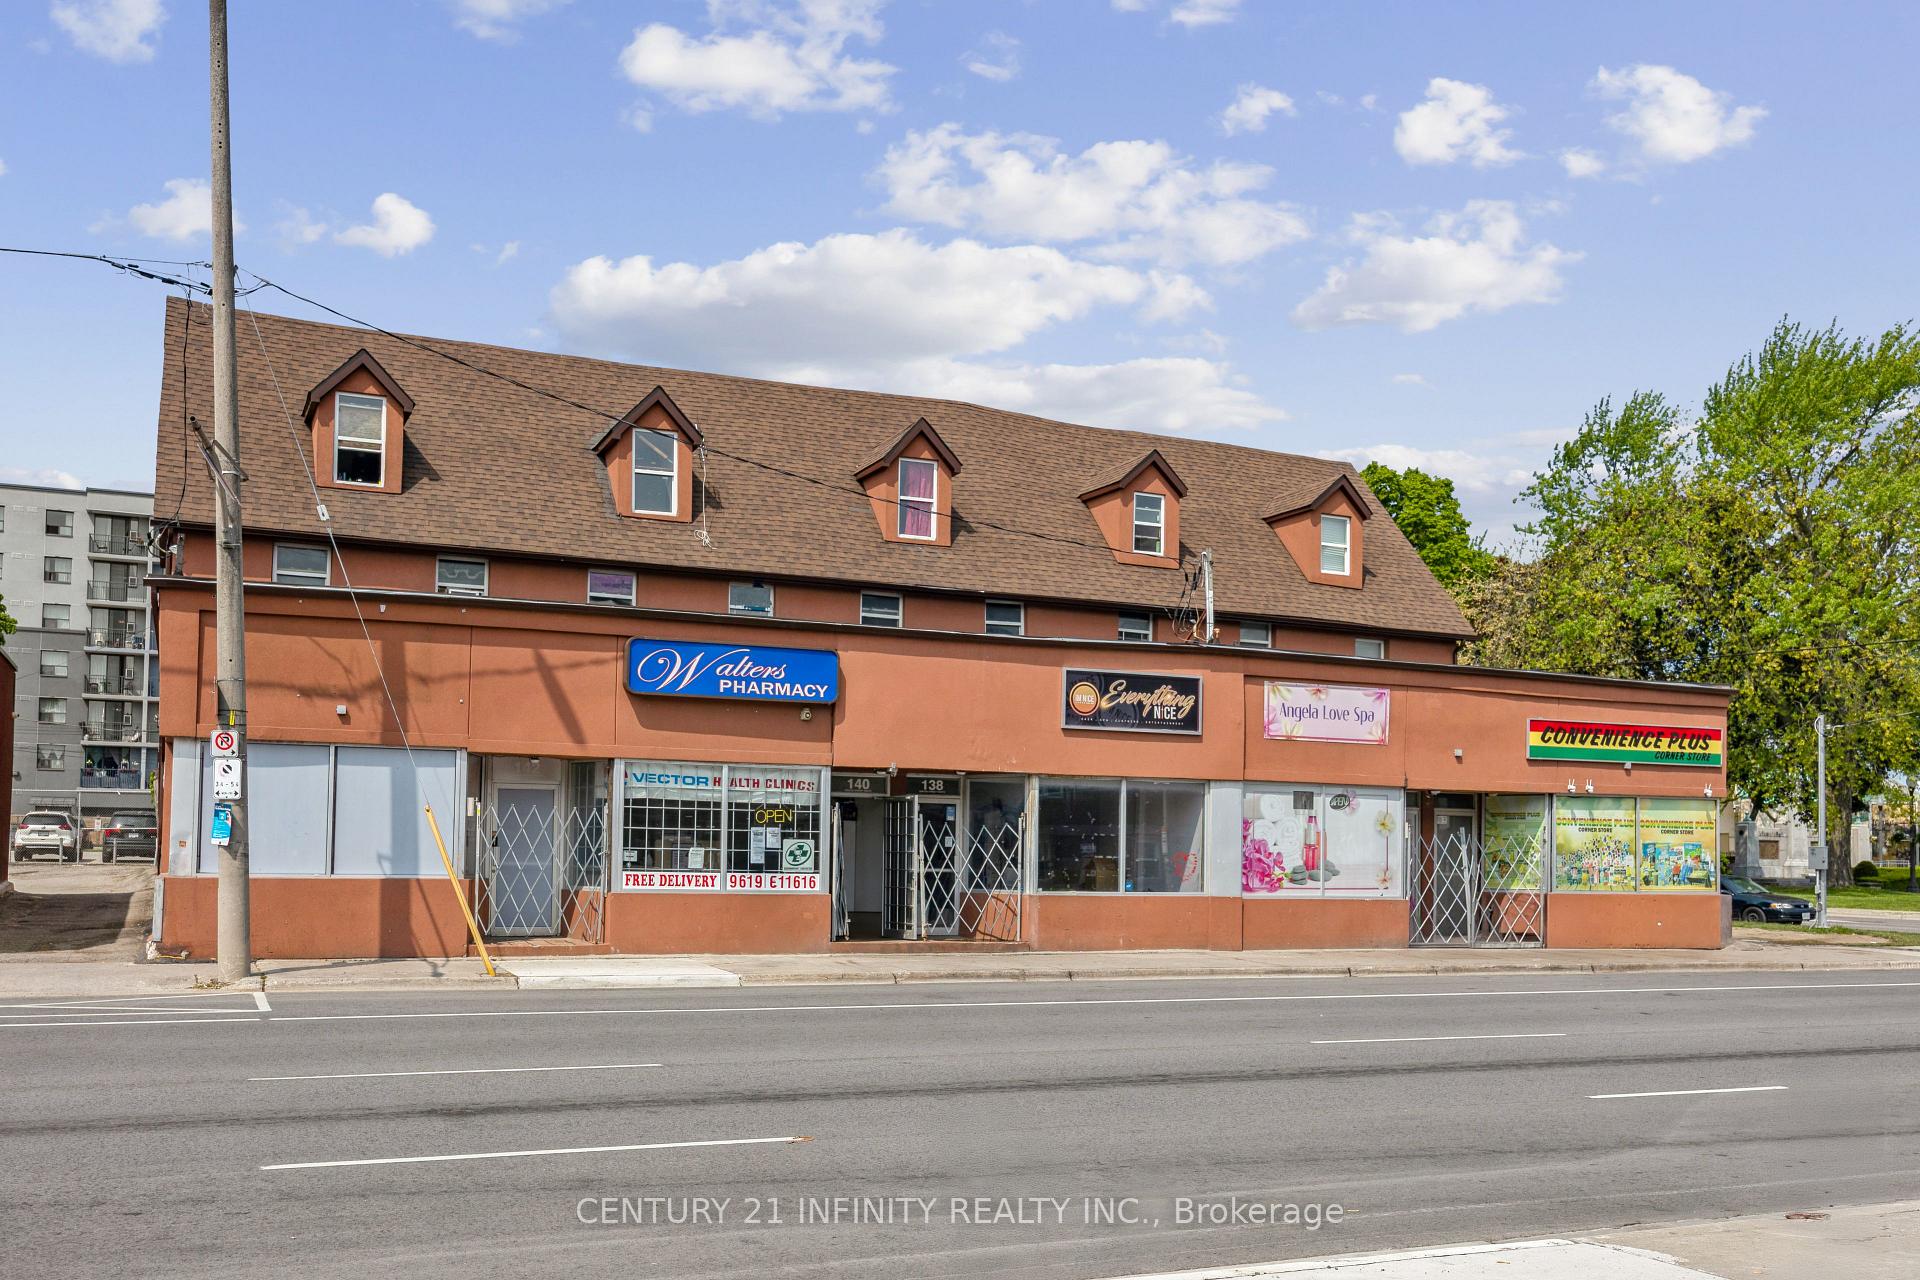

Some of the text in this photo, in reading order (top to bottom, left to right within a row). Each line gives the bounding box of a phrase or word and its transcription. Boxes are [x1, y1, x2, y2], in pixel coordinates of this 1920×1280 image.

[637, 648, 786, 691] Walters
[719, 679, 829, 698] PHARMACY
[1101, 679, 1196, 719] Everything
[1153, 705, 1177, 720] NICE
[1279, 702, 1375, 725] Angela Love Spa
[1540, 726, 1712, 751] CONVENIENCE PLUS
[1654, 751, 1711, 762] CORNER STORE
[632, 772, 815, 791] VECTOR HALTH CLINICS
[847, 778, 870, 790] 140
[921, 779, 944, 791] 138
[755, 808, 793, 824] OPEN
[625, 873, 718, 889] FREE DELIVERY
